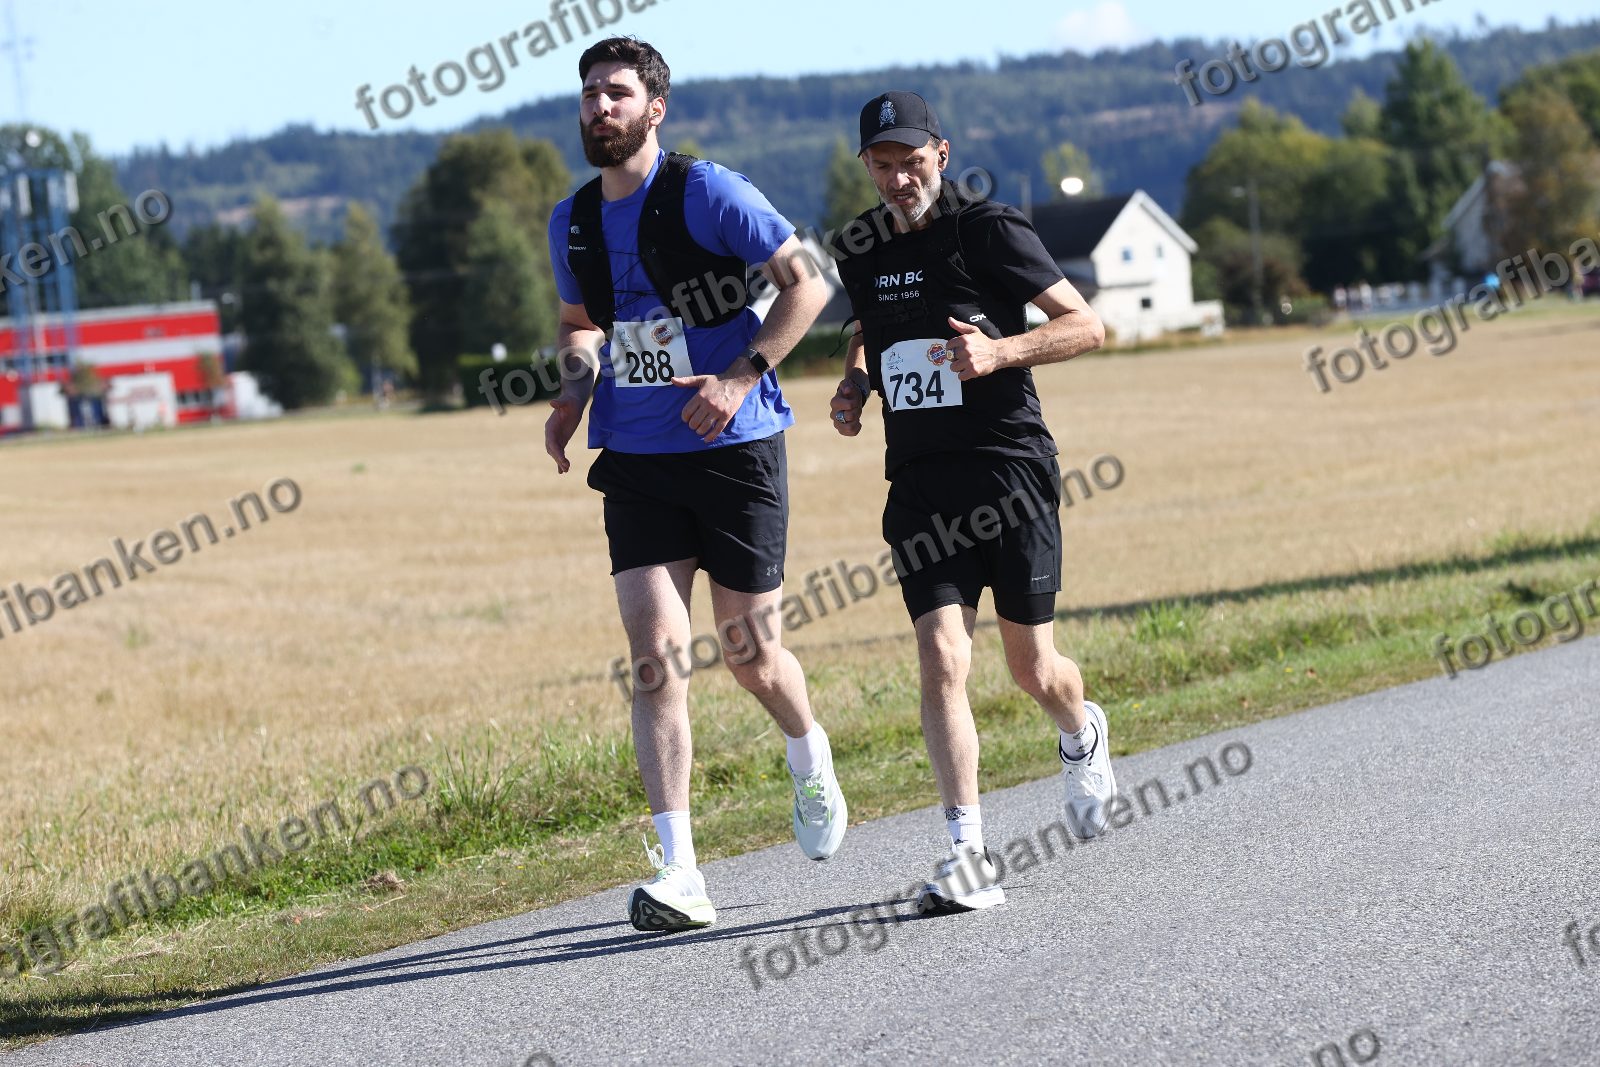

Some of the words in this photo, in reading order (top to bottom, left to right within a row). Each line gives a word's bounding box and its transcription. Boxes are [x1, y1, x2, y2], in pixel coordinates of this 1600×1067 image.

[878, 292, 898, 302] SINCE
[900, 290, 920, 300] 1956
[626, 350, 674, 383] 288
[890, 370, 944, 407] 734
